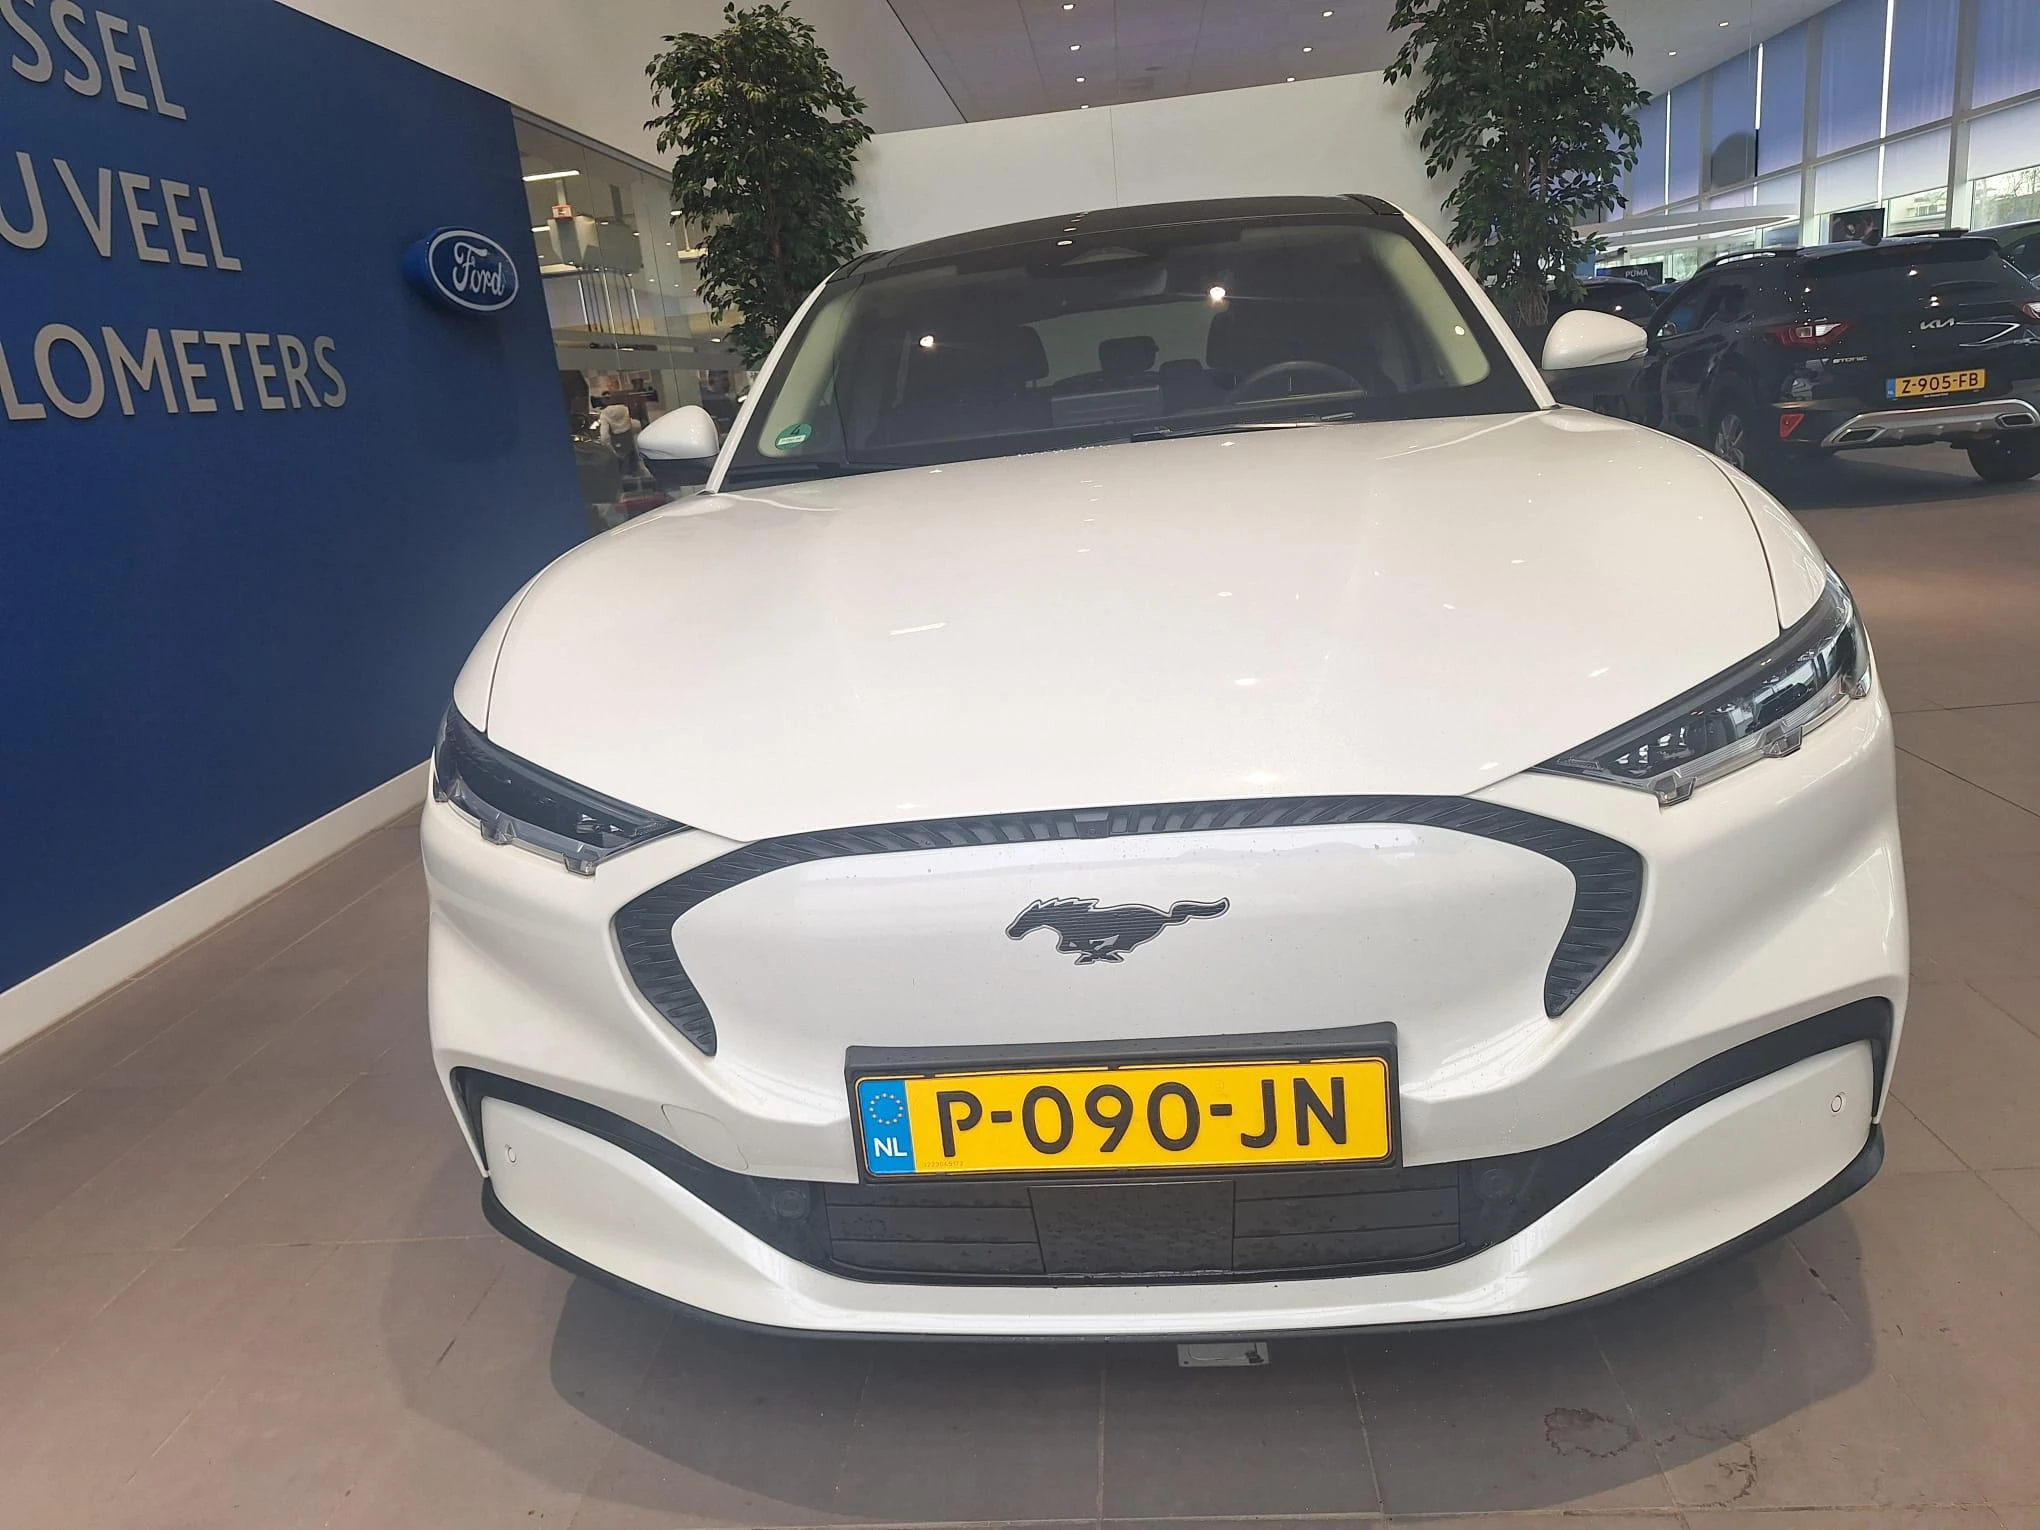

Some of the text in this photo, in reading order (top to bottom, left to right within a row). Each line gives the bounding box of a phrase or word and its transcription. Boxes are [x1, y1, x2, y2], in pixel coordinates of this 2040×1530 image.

[452, 241, 505, 296] Ford
[1625, 269, 1648, 278] PUMA
[1920, 318, 1955, 330] KIA
[0, 323, 346, 420] LOMETERS
[1902, 372, 1979, 394] Z-905-FB
[873, 1076, 1347, 1158] NL P-090-JN
